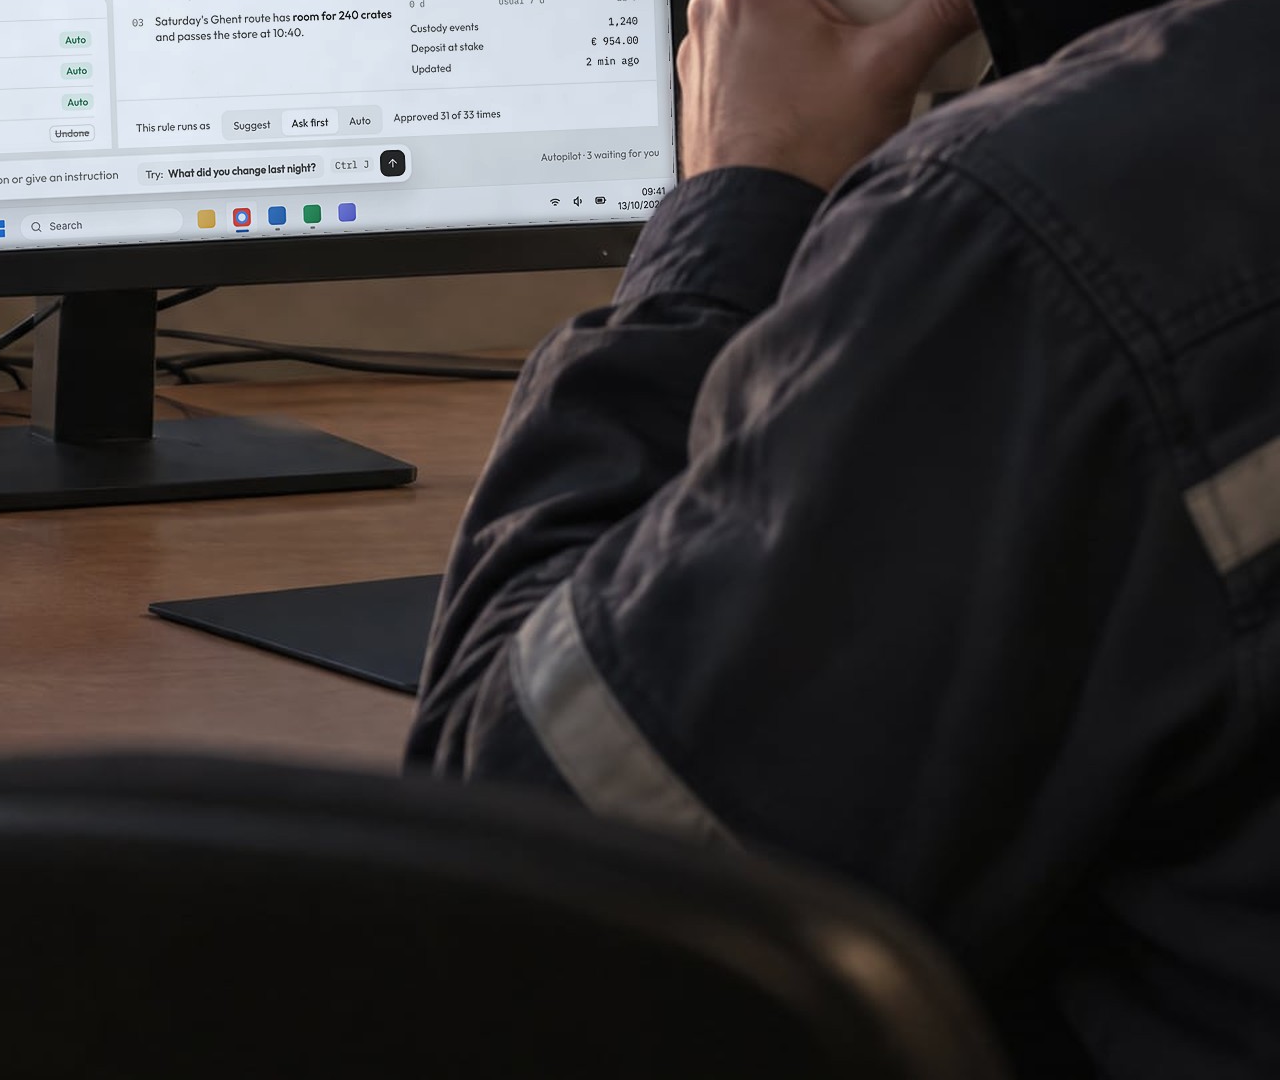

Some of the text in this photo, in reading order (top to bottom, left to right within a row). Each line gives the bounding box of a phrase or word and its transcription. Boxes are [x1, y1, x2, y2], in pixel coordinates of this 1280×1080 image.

[608, 16, 638, 27] 1,240
[410, 22, 479, 34] Custody events
[64, 35, 86, 44] Auto
[67, 98, 89, 107] Auto
[393, 110, 501, 124] Approved 31 of 33 times
[54, 129, 90, 138] Undone
[334, 159, 369, 170] Ctrl J
[145, 162, 316, 181] Try: What did you change last night?
[642, 187, 666, 196] 09:41
[618, 200, 661, 210] 13/10/202
[49, 220, 82, 231] Search
